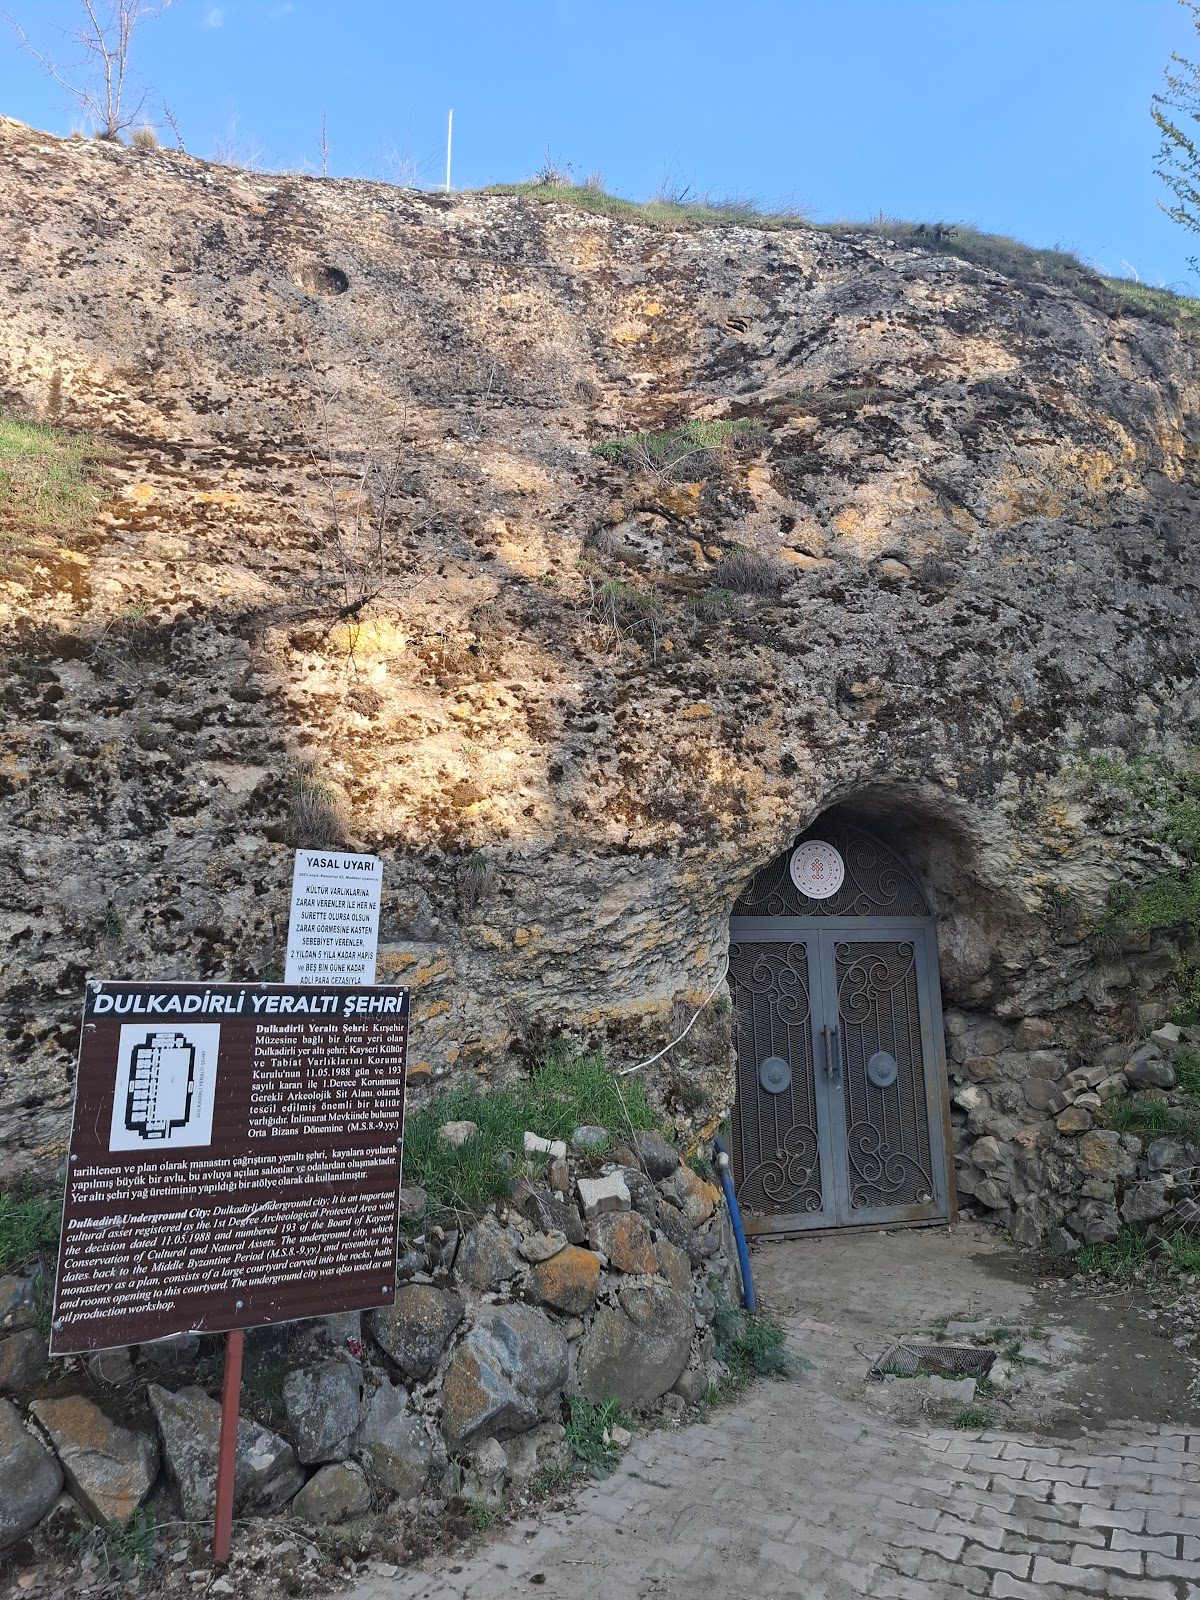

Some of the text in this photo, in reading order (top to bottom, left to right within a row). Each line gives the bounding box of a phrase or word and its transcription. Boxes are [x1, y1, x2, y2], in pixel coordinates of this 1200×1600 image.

[307, 858, 374, 871] YASAL UYARI
[306, 885, 369, 896] KÜLTÜR VARLIKLARINA
[296, 898, 315, 906] ZARAR
[317, 900, 345, 908] VERENLER
[347, 899, 355, 908] İLE
[369, 902, 376, 910] NE
[329, 912, 350, 920] OLURSA
[296, 924, 372, 934] ZARAR GÖRMESİNE KASTEN
[302, 937, 364, 947] SEBEBİYET VERENLER,
[291, 950, 294, 958] 2
[357, 950, 373, 959] HAPİS
[306, 964, 316, 973] BEŞ
[318, 962, 328, 972] BİN
[330, 963, 344, 972] GÜNE
[346, 964, 365, 972] KADAR
[300, 975, 313, 984] ADLİ
[93, 990, 403, 1017] DULKADİRLİ YERALTI ŞEHRİ
[256, 1024, 404, 1033] Dulkadirli Yeraltı Şehri: Kırşehir
[255, 1034, 403, 1045] Müzesine bağlı bir ören yeri olan
[255, 1045, 403, 1057] Dulkadirli yer altı şehri; Kayseri Kültür
[271, 1058, 301, 1067] Tabiat
[308, 1057, 362, 1066] Varlıklarını
[368, 1056, 402, 1064] Koruma
[253, 1070, 300, 1079] Kurulu'nun
[306, 1068, 350, 1077] 11.05.1988
[355, 1068, 370, 1077] gün
[389, 1066, 401, 1074] 193
[252, 1081, 274, 1092] sayılı
[279, 1081, 302, 1089] kararı
[308, 1080, 318, 1089] ile
[361, 1078, 400, 1086] Korunması
[251, 1087, 400, 1102] Gerekli Arkeolojik Sit Alanı olarak
[250, 1099, 400, 1114] tescil edilmiş önemli bir kültür
[249, 1115, 289, 1127] varlığıdır.
[328, 1111, 369, 1120] Mevkiinde
[370, 1110, 399, 1118] bulunan
[248, 1128, 266, 1137] Orta
[272, 1127, 299, 1136] Bizans
[304, 1124, 343, 1134] Dönemine
[73, 1166, 121, 1177] tarihlenen
[137, 1162, 158, 1175] plan
[160, 1160, 188, 1171] olarak
[190, 1159, 231, 1168] manastırı
[233, 1156, 276, 1167] çağrıştıran
[278, 1151, 304, 1164] yeraltı
[306, 1150, 327, 1162] şehri,
[332, 1148, 364, 1159] kayalara
[366, 1145, 397, 1156] oyularak
[72, 1156, 397, 1192] yapılmış büyük bir avlu, bu avluya açılan salonlar ve odalardan oluşmaktadır.
[72, 1171, 368, 1203] Yer altı şehri yağ üretiminin yapıldığı bir atölye olarak da kullanılmıştır.
[66, 1229, 106, 1242] cultural
[108, 1228, 132, 1238] asset
[135, 1222, 182, 1237] registered
[196, 1220, 210, 1229] the
[213, 1219, 226, 1228] 1st
[228, 1217, 259, 1227] Degree
[261, 1209, 318, 1223] Archeological
[320, 1204, 358, 1217] Protected
[359, 1204, 377, 1213] Area
[379, 1201, 394, 1210] with
[65, 1212, 394, 1255] the decision dated 11.05.1988 and numbered 193 of the Board of Kayseri
[64, 1254, 130, 1269] Conservation
[134, 1251, 146, 1263] of
[148, 1247, 187, 1260] Cultural
[190, 1244, 208, 1255] and
[211, 1241, 245, 1253] Natural
[248, 1239, 276, 1249] Assets.
[281, 1235, 296, 1245] The
[299, 1228, 350, 1242] underground
[372, 1224, 394, 1234] which
[59, 1300, 175, 1324] oil production workshop.
